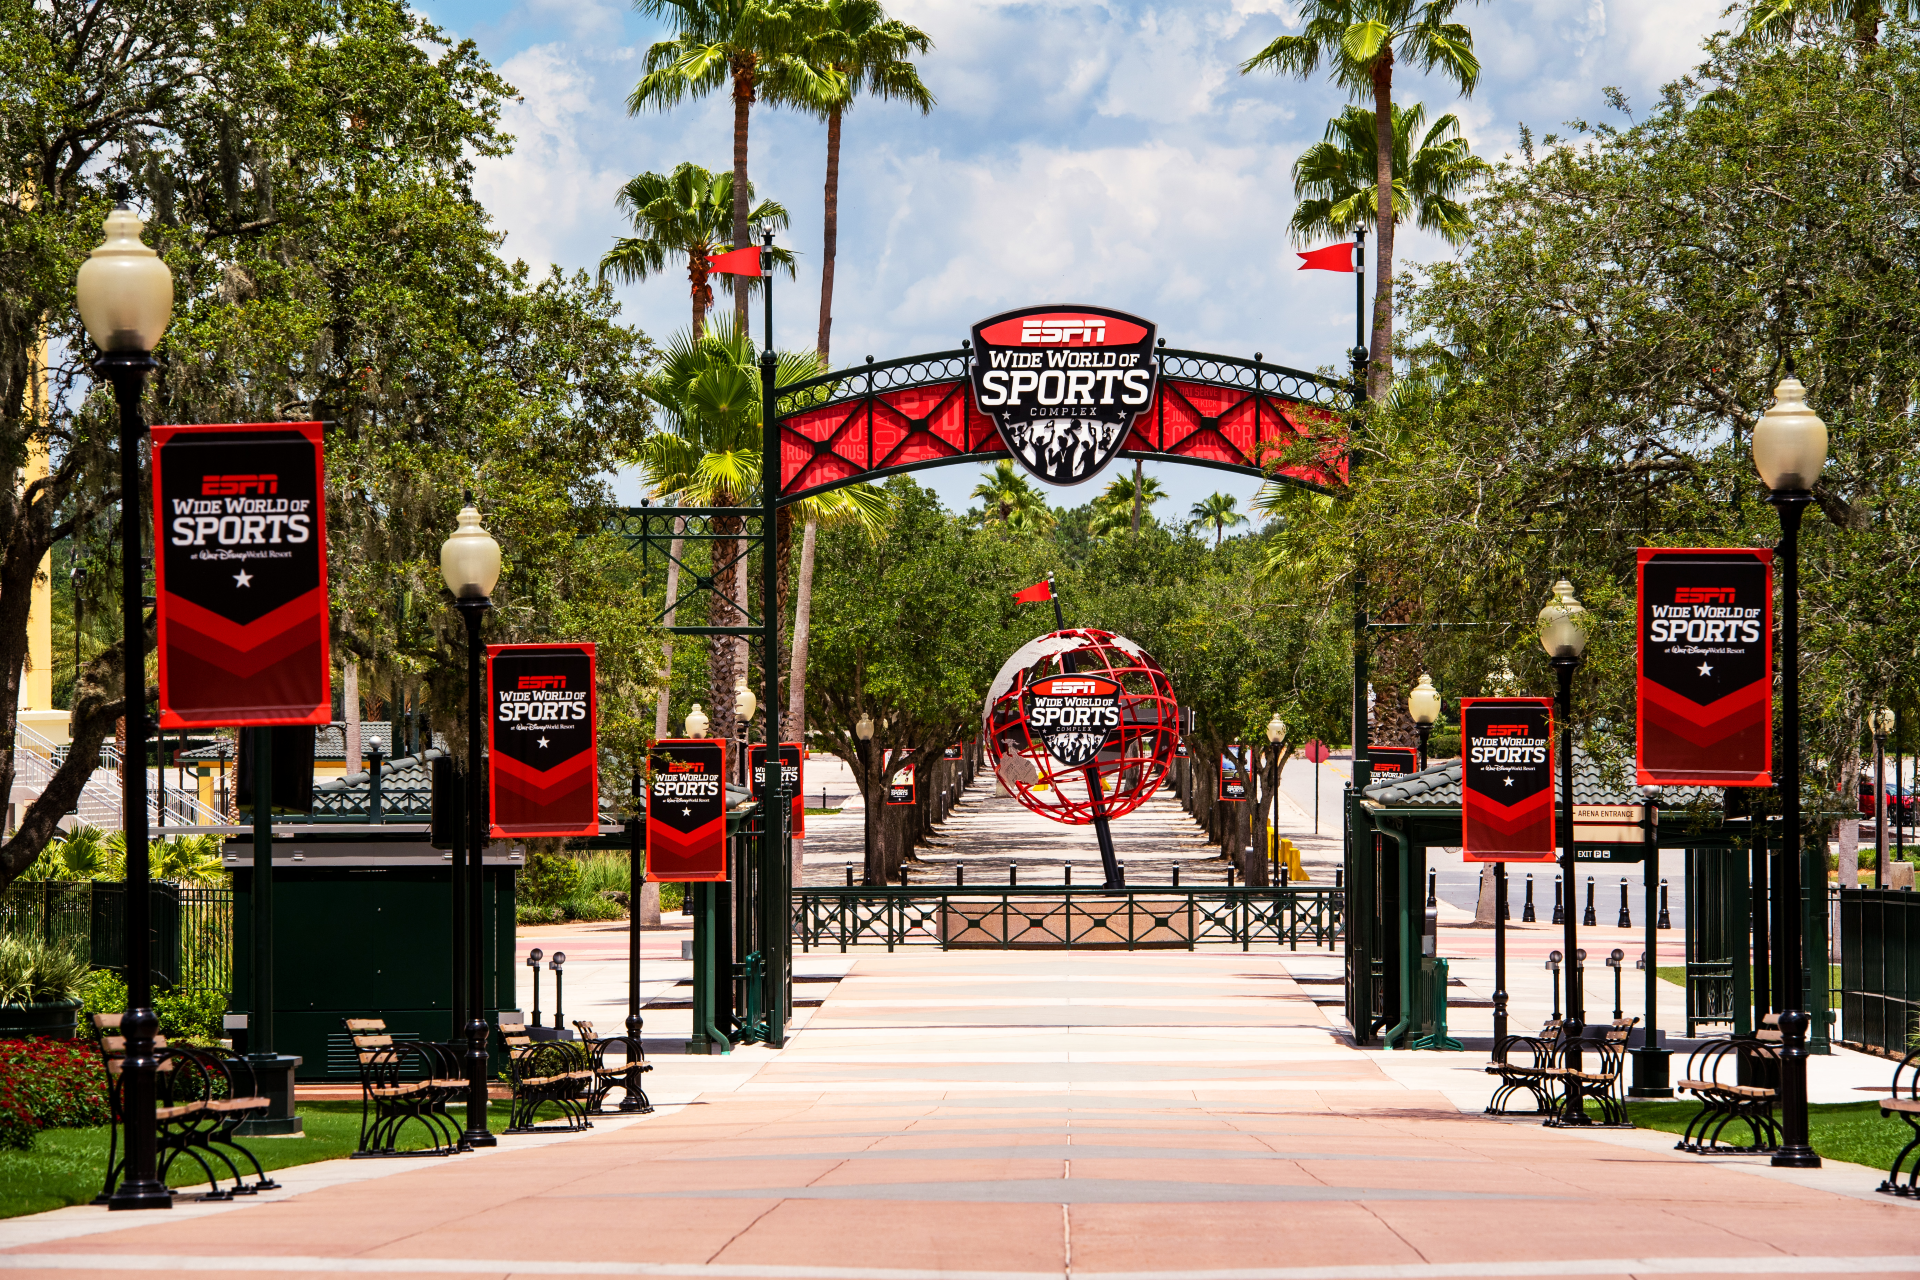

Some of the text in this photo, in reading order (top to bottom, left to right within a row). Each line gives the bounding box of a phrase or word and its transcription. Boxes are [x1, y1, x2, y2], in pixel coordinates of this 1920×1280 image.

[1021, 320, 1106, 343] ESPN
[981, 370, 1150, 406] SPORTS
[1195, 387, 1218, 397] SERVE
[1171, 400, 1218, 408] CORER KICK
[1030, 407, 1097, 416] COMPLEX
[202, 474, 278, 495] ESPN
[172, 514, 310, 546] SPORTS
[269, 550, 292, 558] Resort
[1674, 587, 1736, 603] ESPN
[1650, 620, 1760, 642] SPORTS
[518, 676, 566, 689] ESPN
[1052, 682, 1095, 694] ESPN
[499, 701, 586, 721] SPORTS
[1031, 707, 1119, 726] SPORTS
[1487, 725, 1528, 736] ESPN
[1471, 747, 1546, 763] SPORTS
[669, 762, 704, 772] ESPN
[1374, 763, 1400, 771] ESPN
[654, 782, 718, 796] SPORTS
